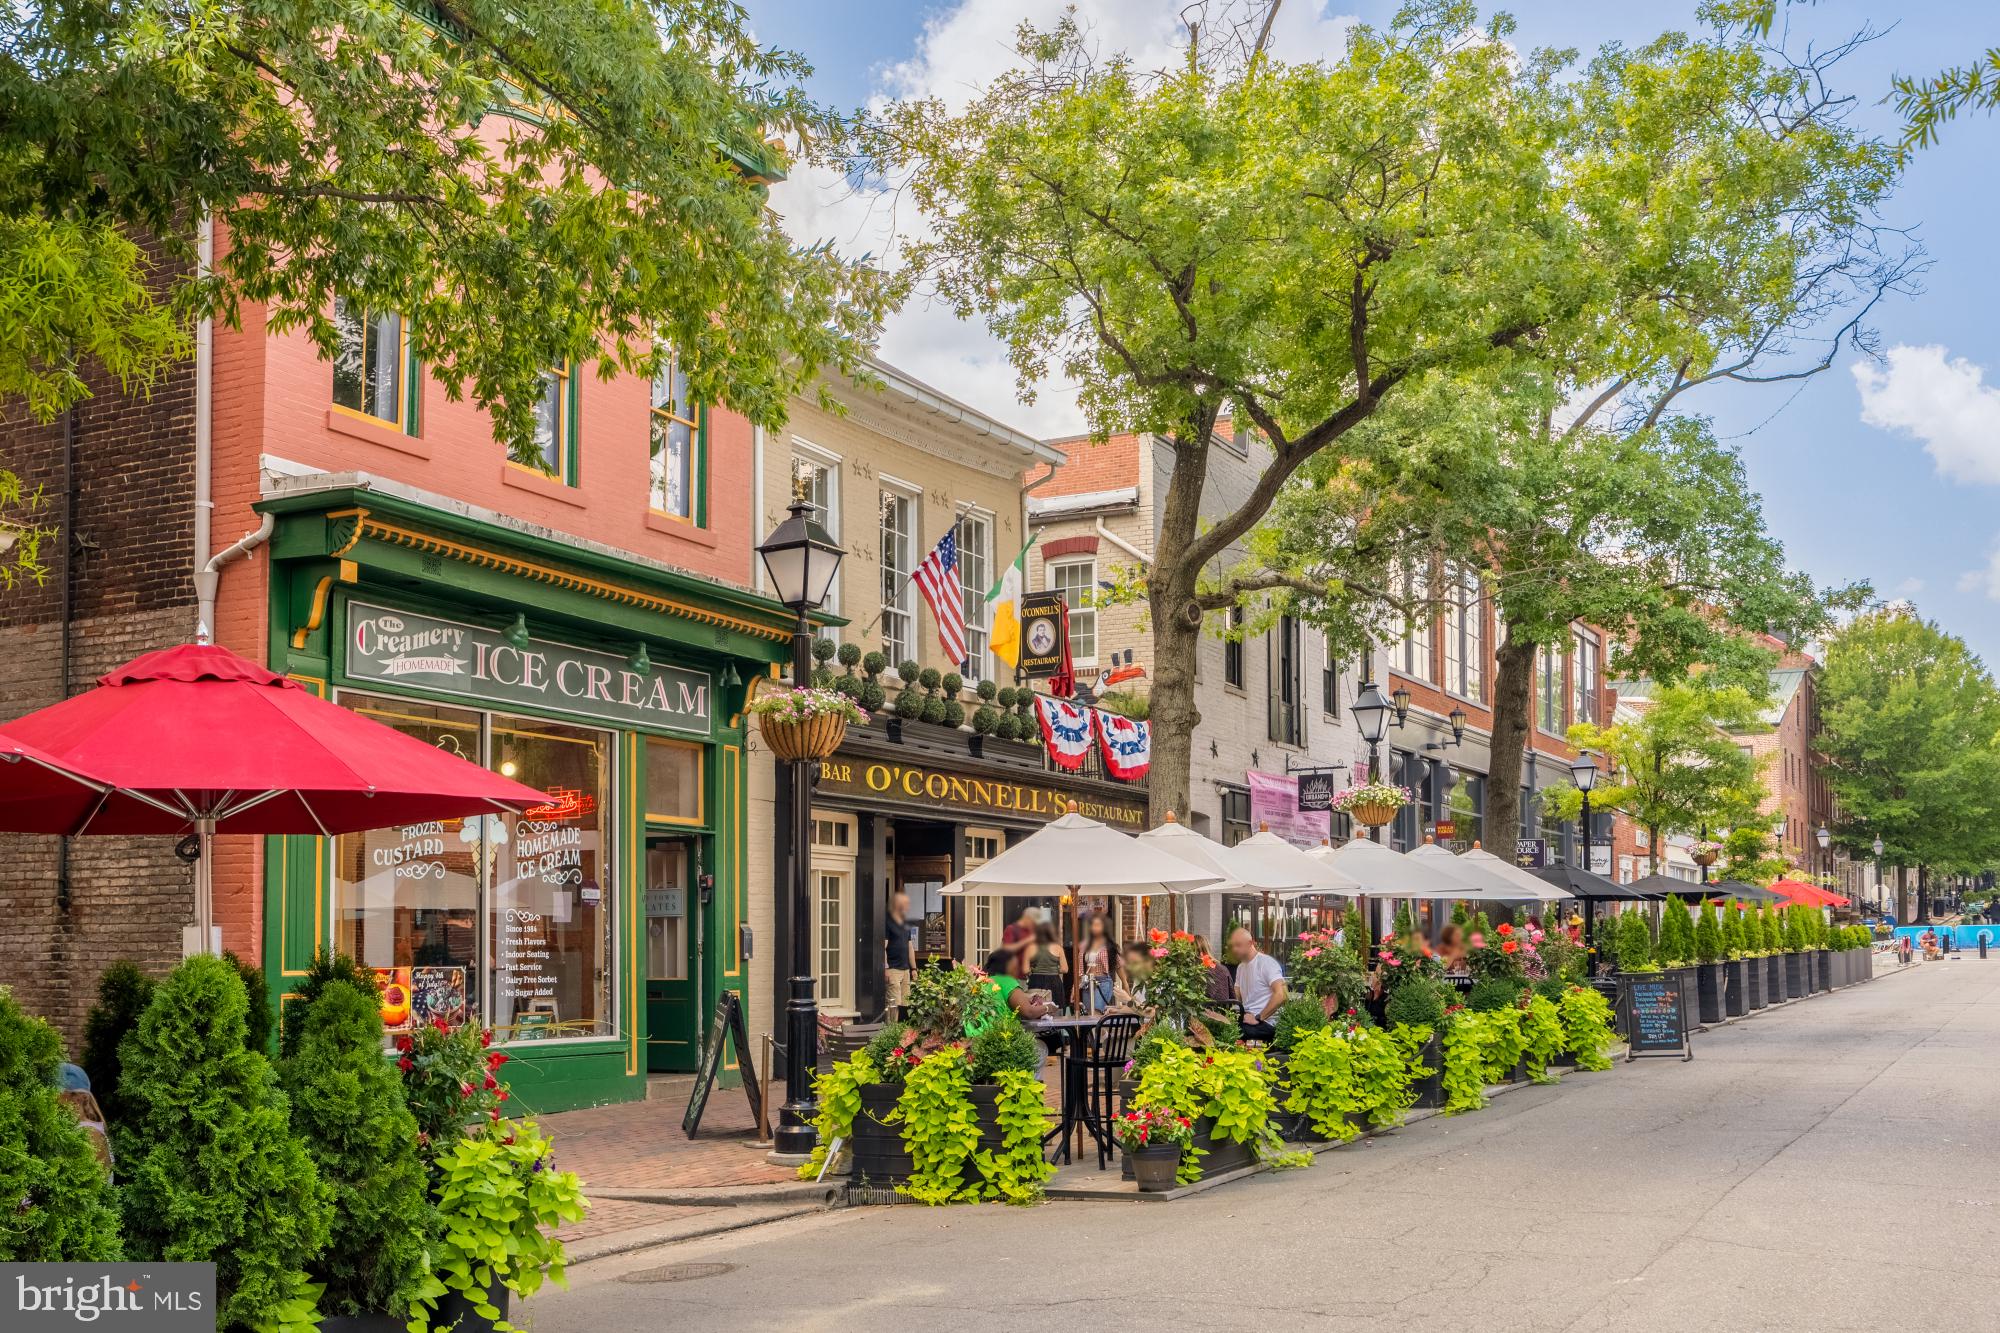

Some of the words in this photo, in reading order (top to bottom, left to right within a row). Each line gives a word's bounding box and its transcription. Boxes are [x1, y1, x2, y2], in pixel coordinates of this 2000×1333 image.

[1021, 605, 1060, 618] O'CONNELL'S
[382, 619, 402, 629] The
[356, 619, 465, 656] Creamery
[396, 659, 452, 672] HOMEMADE
[1023, 656, 1060, 666] RESTAURANT
[471, 641, 550, 693] ICE
[556, 660, 707, 718] CREAM
[821, 762, 851, 783] BAR
[865, 764, 1068, 816] O'CONNELL'S
[1078, 801, 1143, 825] RESTAURANT
[402, 821, 444, 842] FROZEN
[516, 828, 582, 858] HOMEMADE
[373, 839, 444, 866] CUSTARD
[516, 860, 537, 880] ICE
[539, 850, 582, 874] CREAM
[505, 925, 523, 933] Since
[505, 938, 523, 946] Fresh
[523, 938, 546, 946] Flavors
[505, 951, 525, 959] Indoor
[526, 950, 550, 960] Seating
[505, 963, 519, 971] Fast
[519, 963, 542, 971] Service
[414, 971, 434, 981] Happy
[435, 971, 444, 979] 4th
[505, 976, 523, 985] Dairy
[523, 976, 537, 984] Free
[537, 975, 558, 984] Sorbet
[505, 989, 514, 997] No
[515, 988, 533, 998] Sugar
[534, 988, 553, 996] Added
